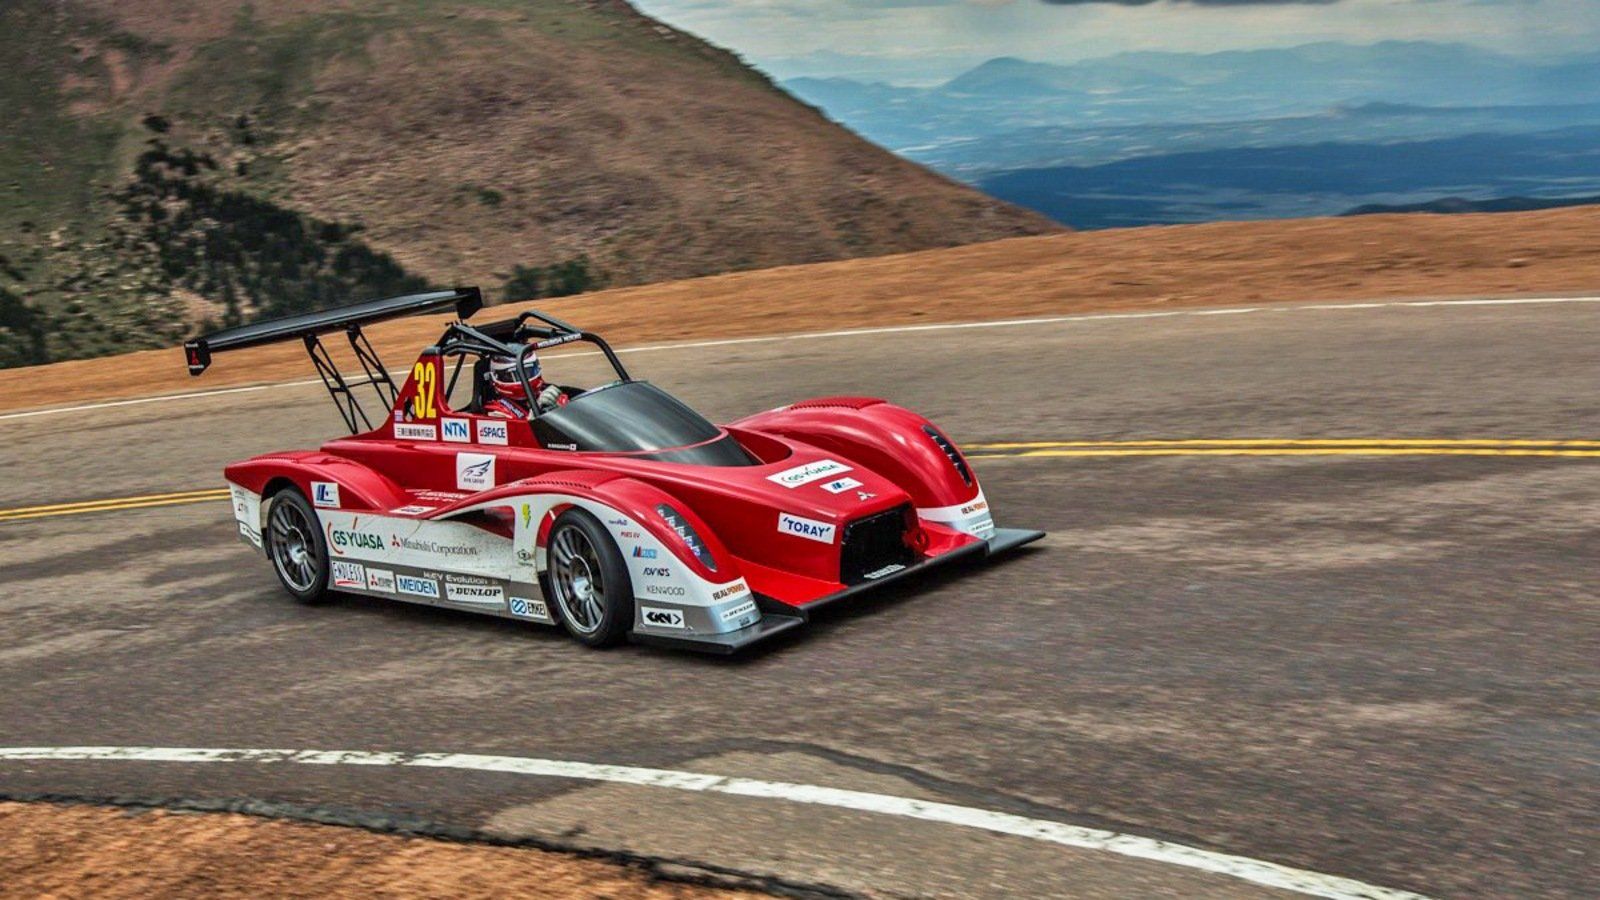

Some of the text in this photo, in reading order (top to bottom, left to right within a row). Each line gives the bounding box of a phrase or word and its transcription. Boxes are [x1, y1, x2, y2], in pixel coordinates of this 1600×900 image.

[414, 361, 437, 419] 32
[444, 422, 468, 438] NTN
[479, 426, 506, 439] dSPACE
[332, 530, 385, 550] GS YUASA
[400, 537, 478, 557] Mitsubishi Corporation
[332, 562, 366, 582] ENDLESS
[446, 574, 489, 586] Evolution
[399, 578, 438, 596] MEIDEN
[455, 587, 502, 597] DUNLOP
[646, 584, 685, 596] KENWOOD
